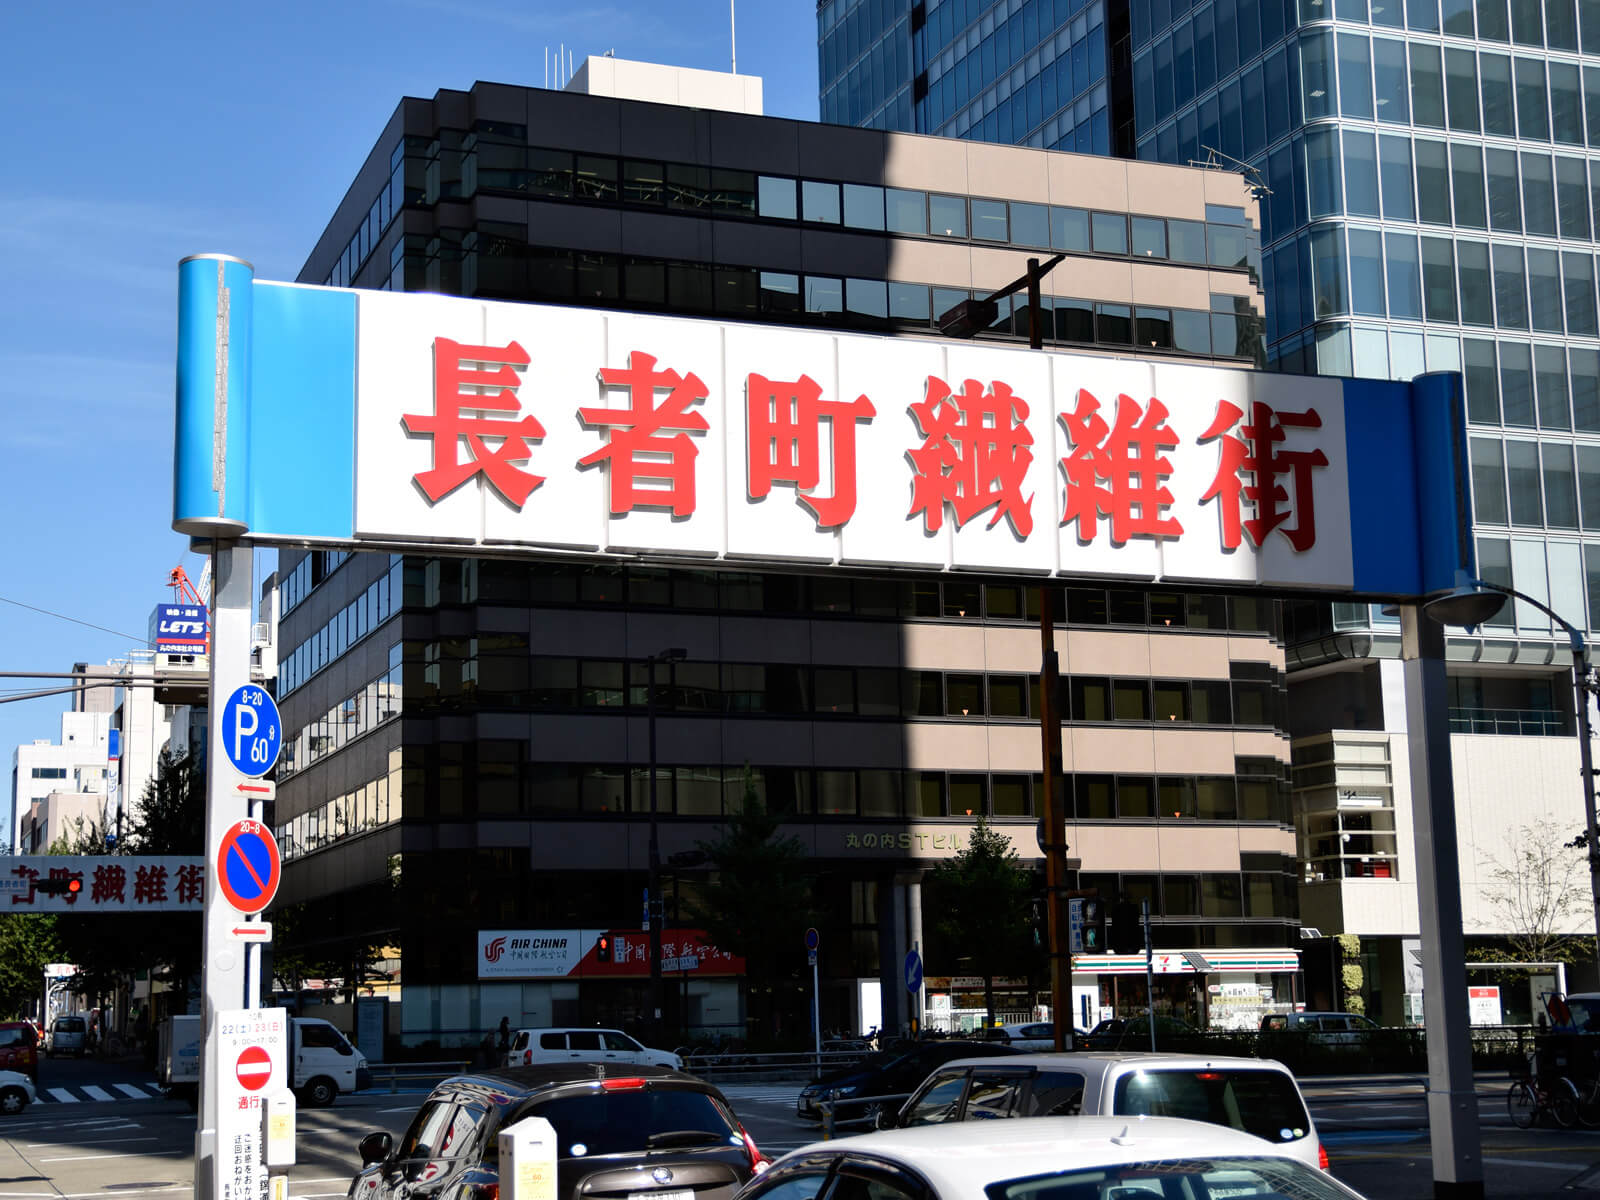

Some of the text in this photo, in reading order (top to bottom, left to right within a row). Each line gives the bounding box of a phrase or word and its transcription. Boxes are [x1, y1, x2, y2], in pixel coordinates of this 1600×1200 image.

[242, 689, 263, 706] 8-20
[235, 704, 259, 761] P
[251, 737, 268, 764] 60
[240, 821, 260, 834] 20-8
[846, 832, 961, 850] 丸の内STビル
[511, 938, 568, 949] AIR CHINA
[238, 1095, 262, 1110] 通行
